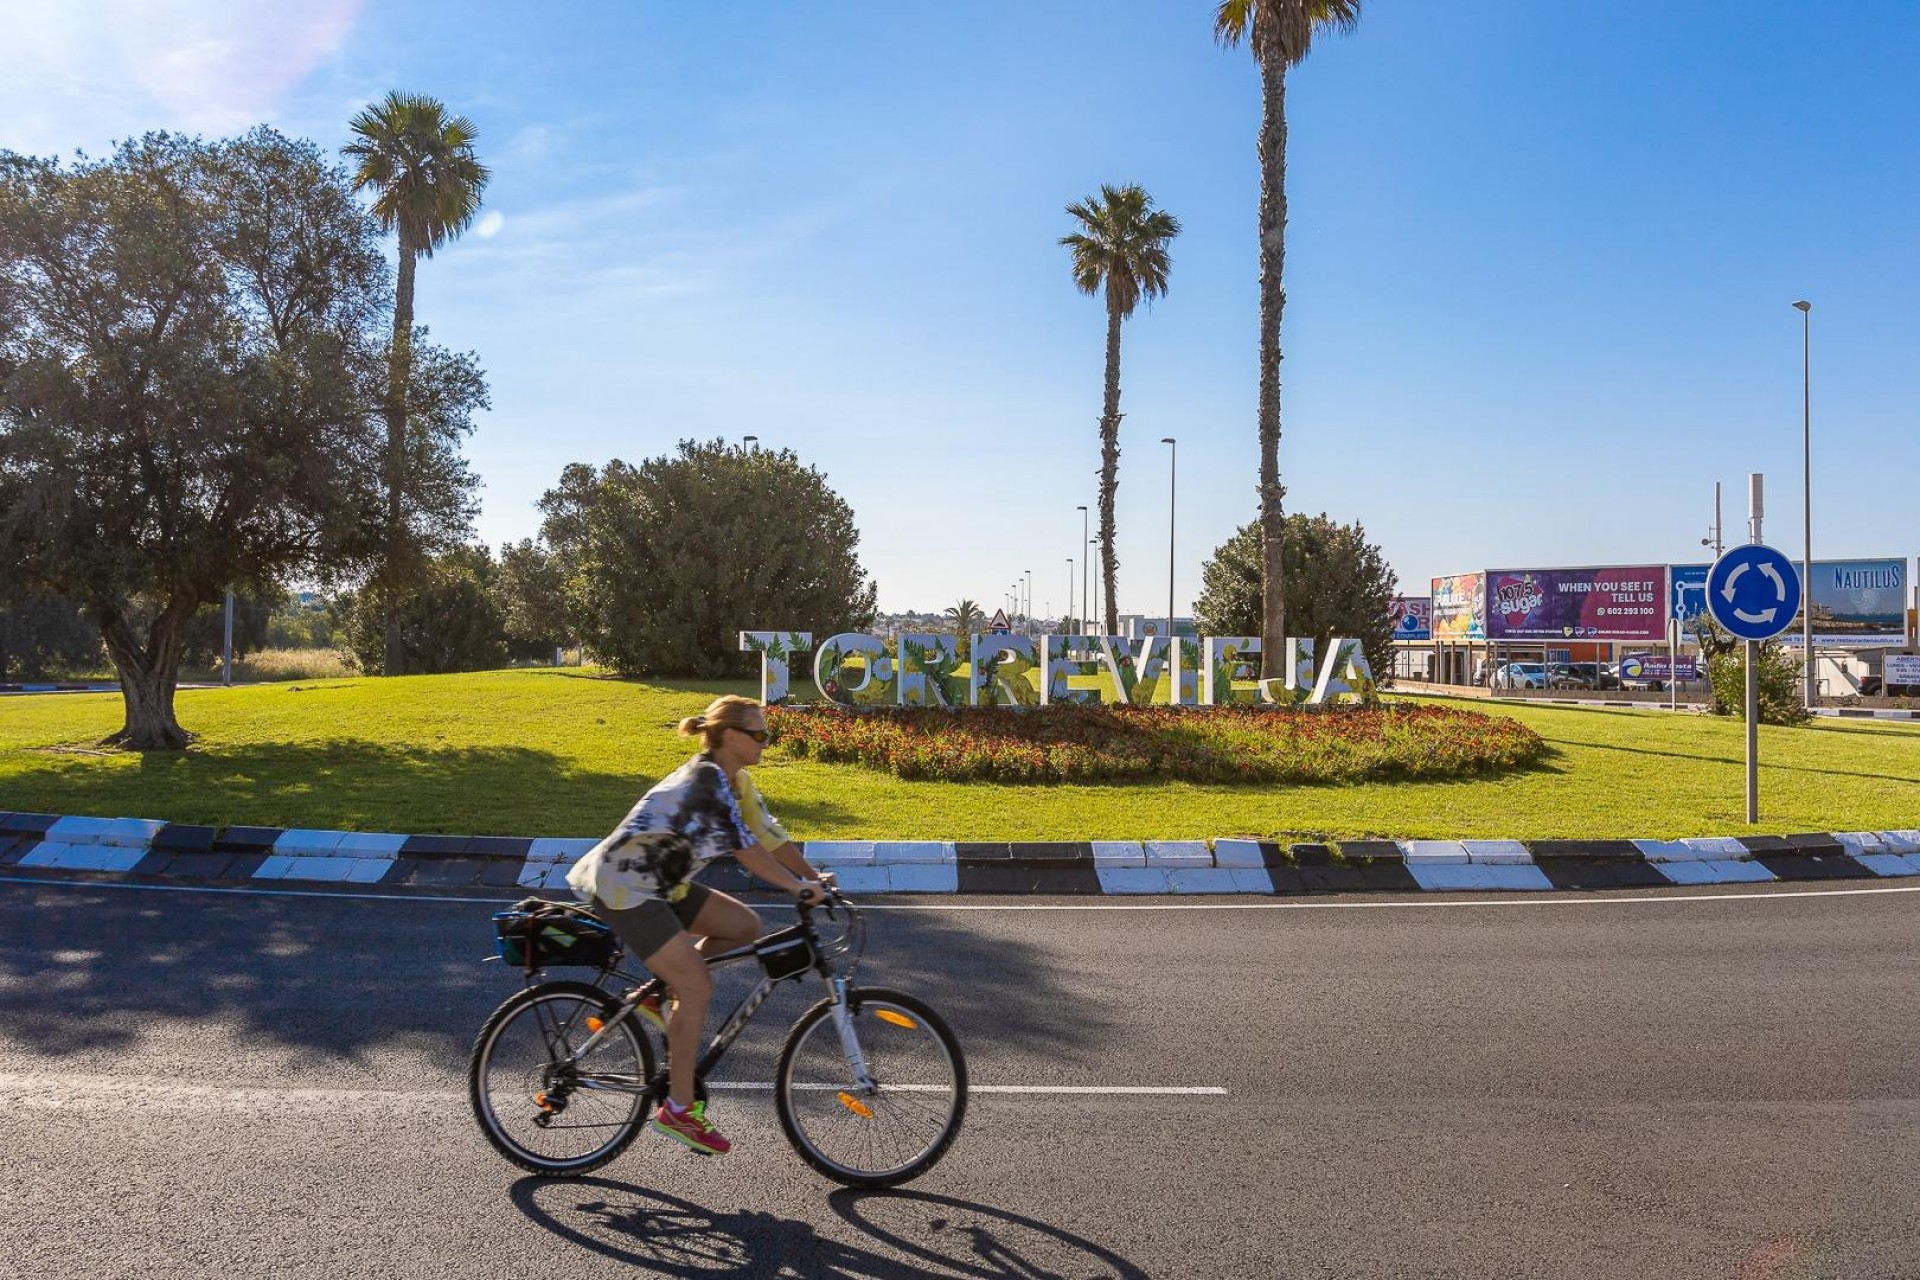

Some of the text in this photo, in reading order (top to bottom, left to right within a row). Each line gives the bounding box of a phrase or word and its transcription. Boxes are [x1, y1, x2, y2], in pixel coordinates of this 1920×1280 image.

[1835, 565, 1900, 589] NAUTILUS
[1558, 581, 1654, 592] WHEN YOU SEE IT
[1500, 593, 1543, 614] sugar
[1611, 593, 1654, 603] TELL US
[1607, 607, 1622, 615] 602
[1640, 607, 1654, 615] 100
[739, 631, 1380, 706] TORREVIEJA
